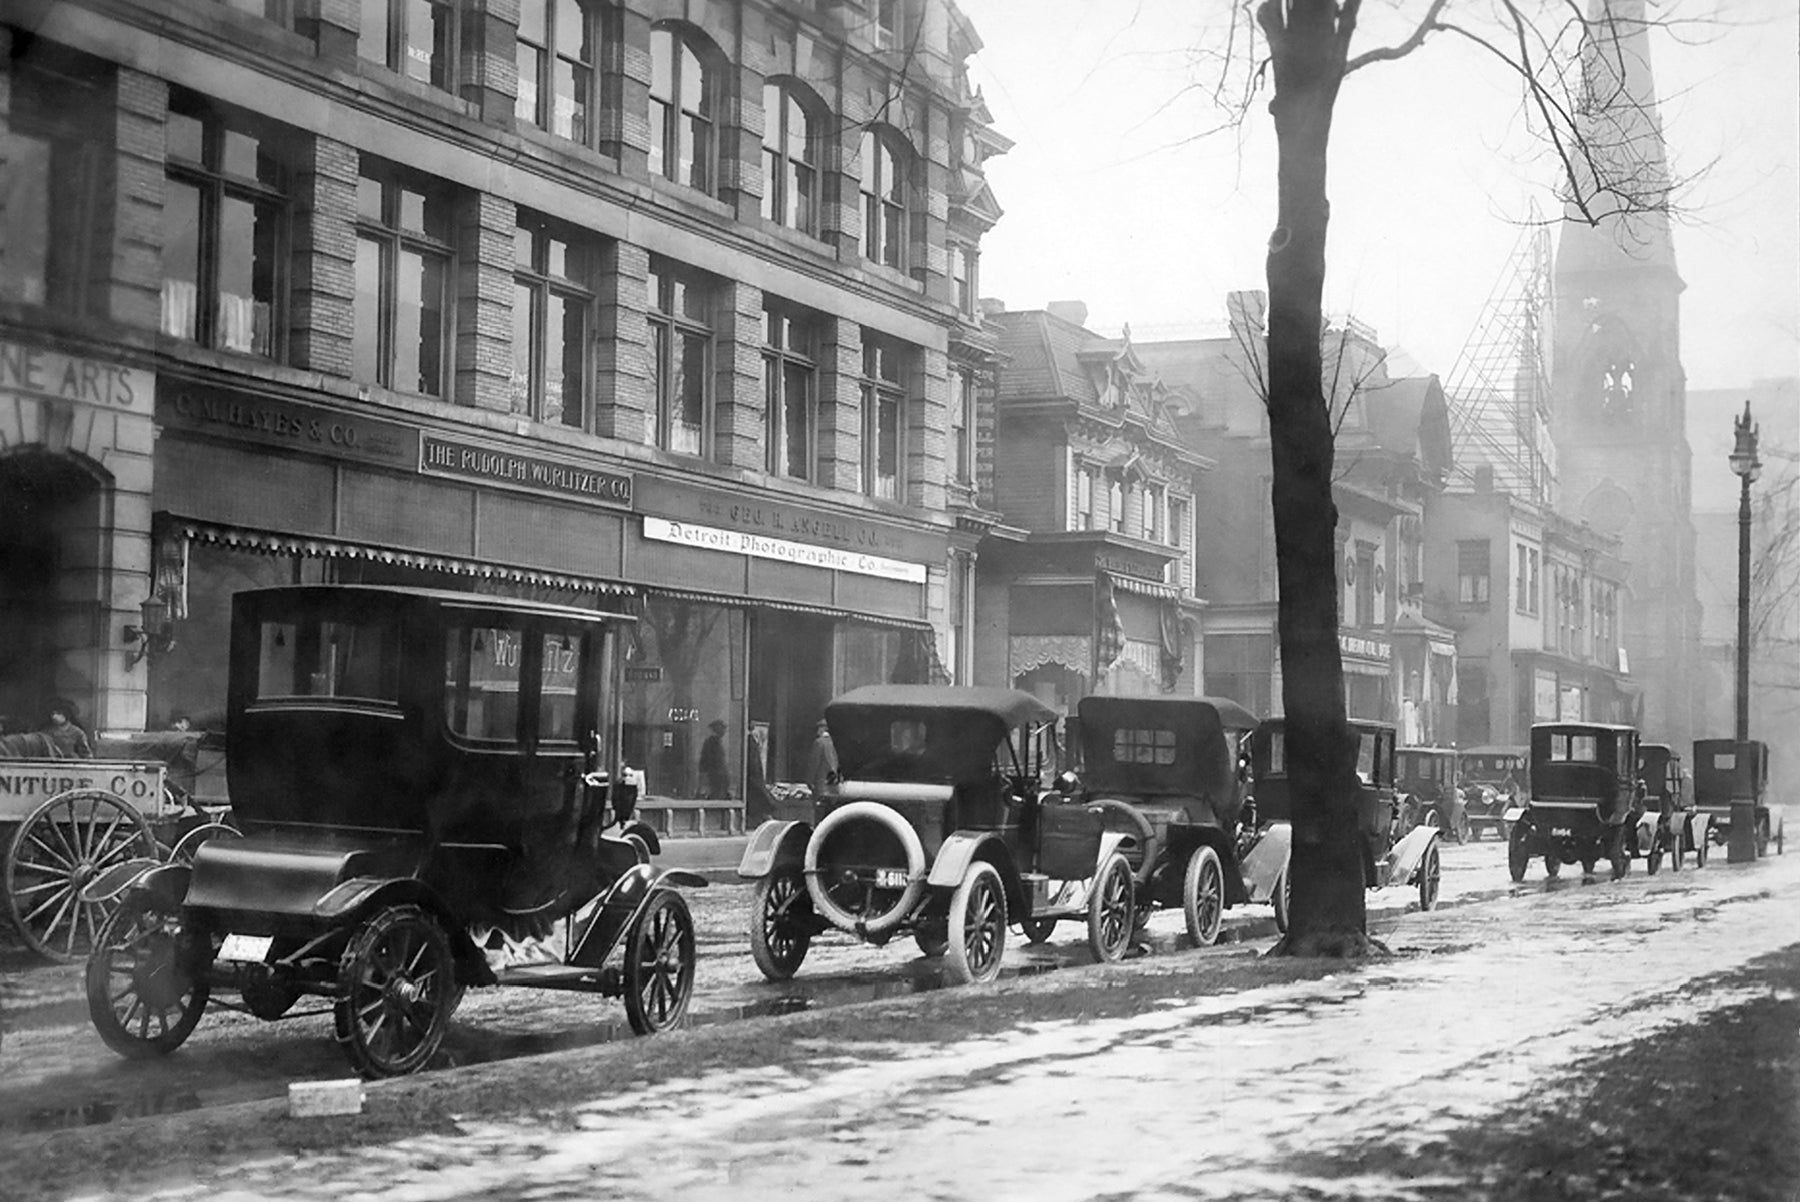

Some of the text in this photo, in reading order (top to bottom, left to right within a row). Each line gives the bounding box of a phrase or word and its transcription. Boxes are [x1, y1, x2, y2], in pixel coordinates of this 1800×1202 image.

[59, 359, 134, 406] ARTS
[308, 419, 322, 442] &
[427, 443, 455, 467] THE
[461, 449, 527, 480] RUDOLPH
[531, 462, 606, 495] WURLITZER
[667, 521, 730, 546] Detroit
[741, 535, 847, 566] Photographic
